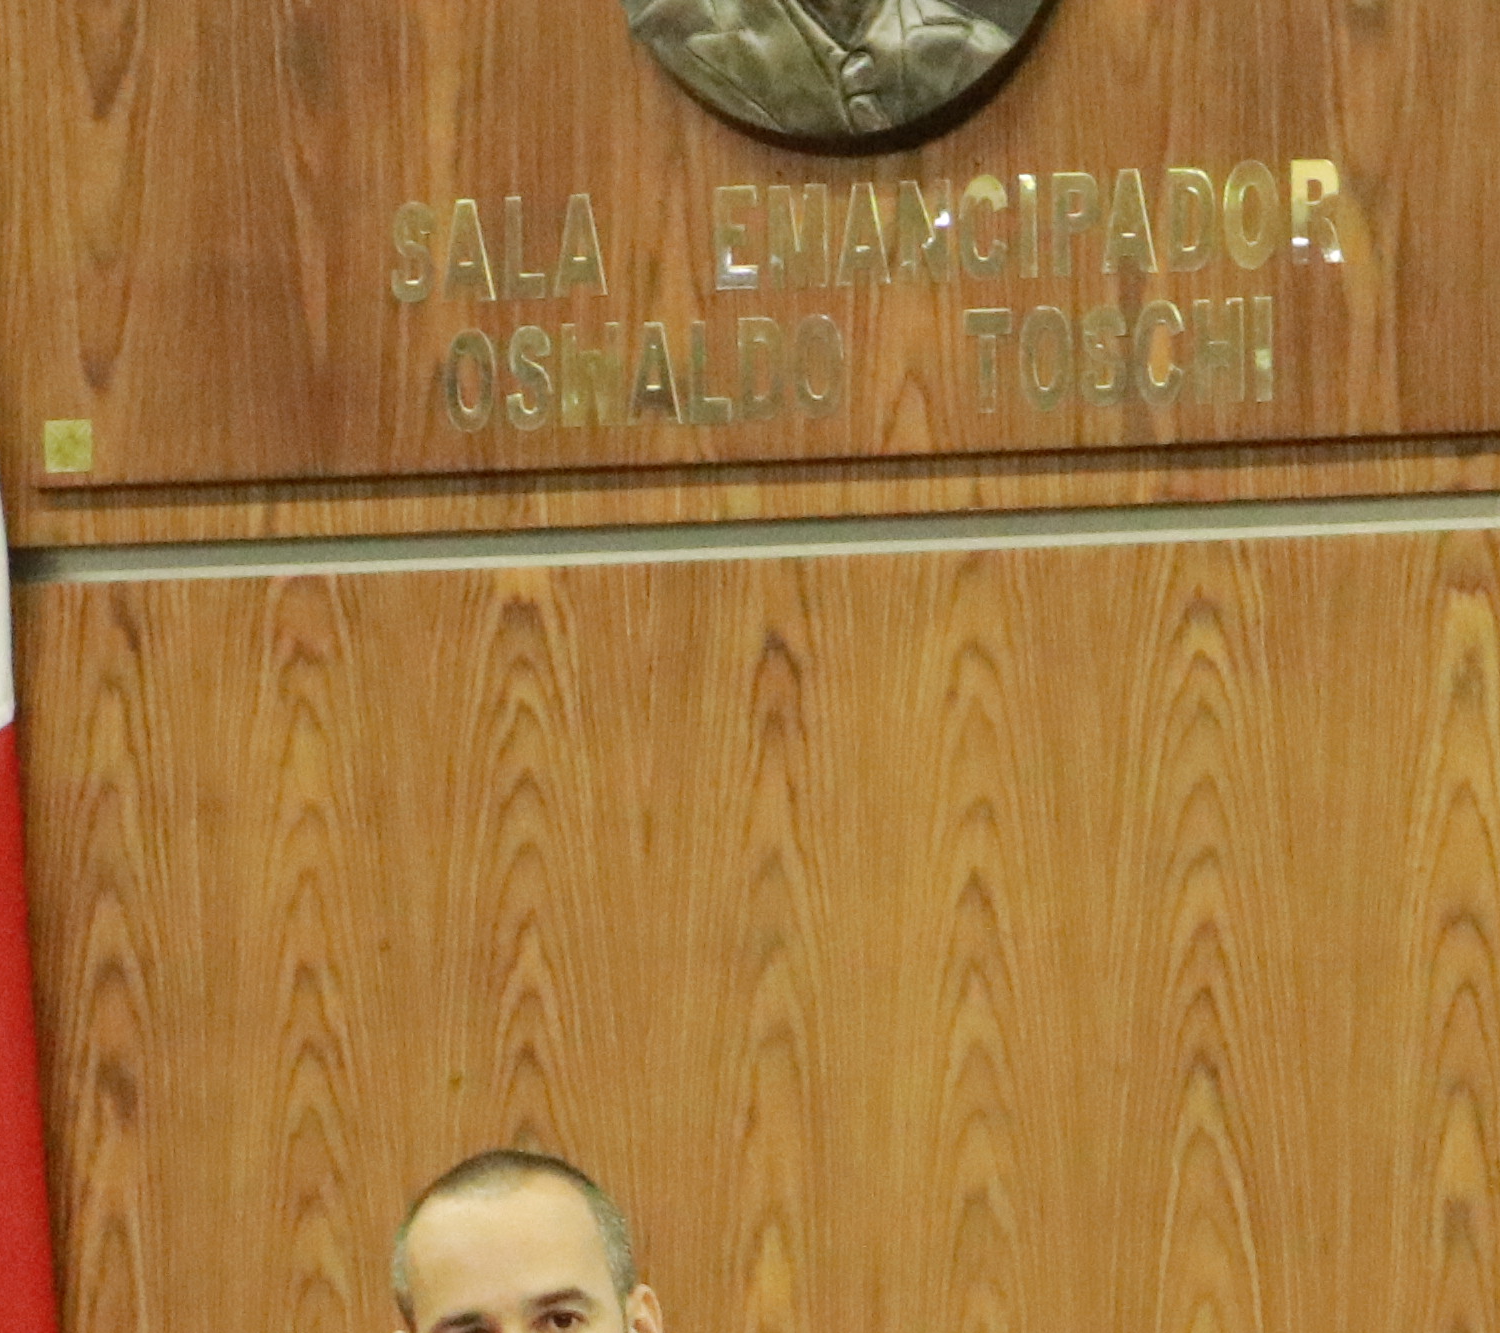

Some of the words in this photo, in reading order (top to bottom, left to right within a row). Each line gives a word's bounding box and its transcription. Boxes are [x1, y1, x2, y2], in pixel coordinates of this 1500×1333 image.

[390, 194, 608, 302] SALA
[712, 159, 1346, 291] EMANCIPADOR
[445, 313, 845, 432] OSWALDO
[962, 296, 1274, 415] TOSCHI
